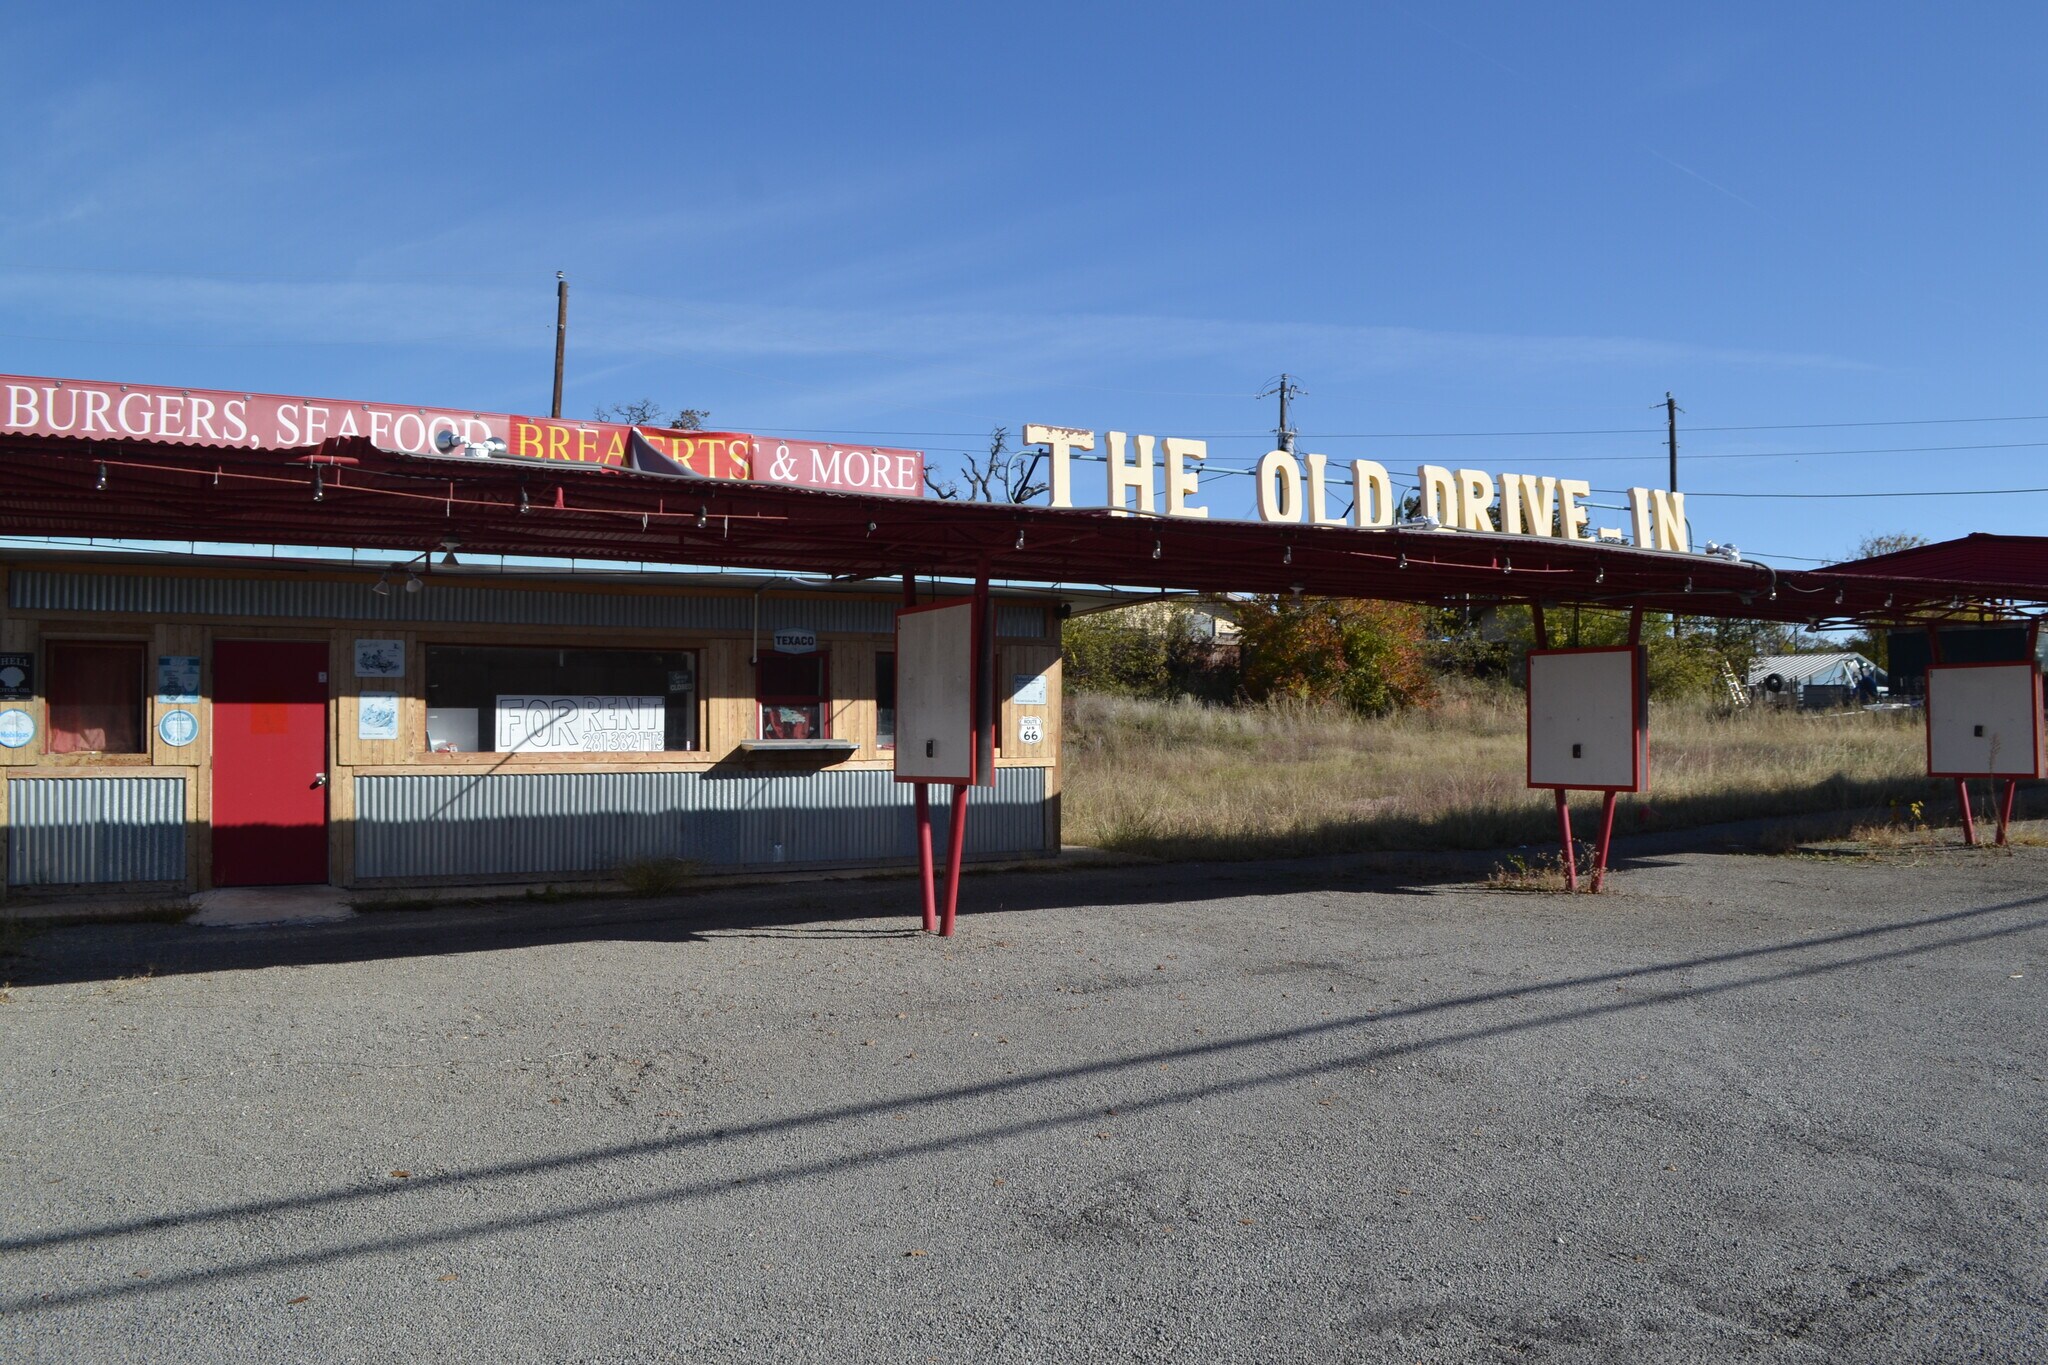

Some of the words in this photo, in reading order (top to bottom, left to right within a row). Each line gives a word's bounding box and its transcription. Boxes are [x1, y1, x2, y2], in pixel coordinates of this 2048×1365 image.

[5, 384, 260, 448] BURGERS,
[276, 404, 492, 455] SEAFOOD
[769, 445, 799, 482] &
[808, 448, 917, 490] MORE
[1023, 423, 1209, 518] THE
[1256, 449, 1393, 529] OLD
[775, 635, 815, 646] TEXACO
[0, 657, 31, 668] HELL
[500, 698, 579, 748] FOR
[583, 696, 664, 732] RENT
[1024, 731, 1038, 741] 66
